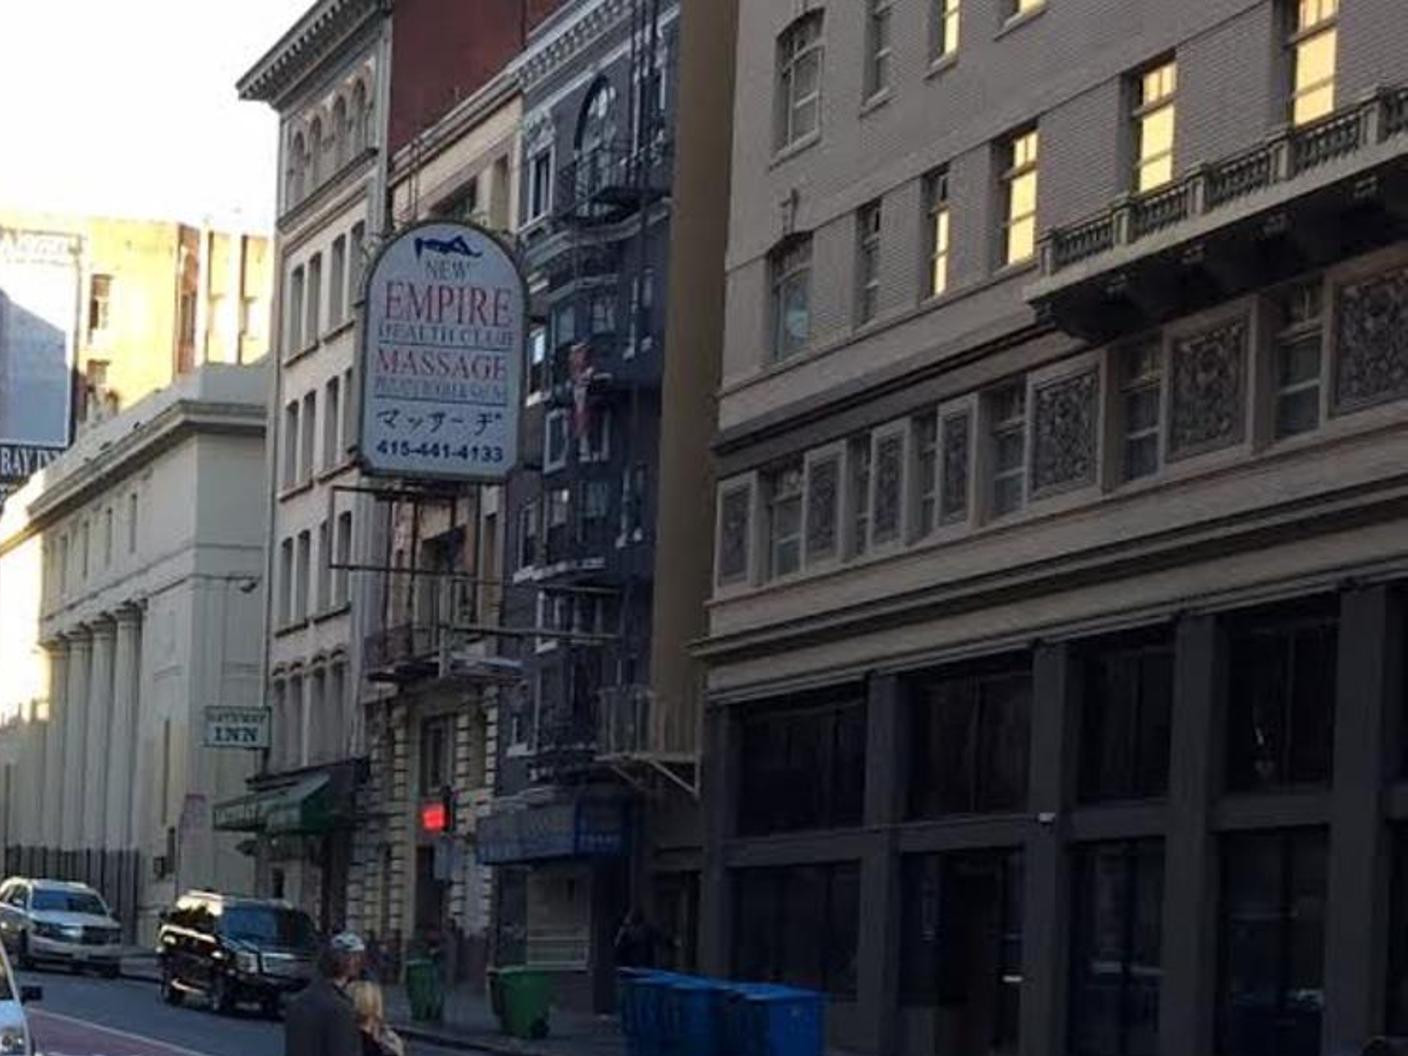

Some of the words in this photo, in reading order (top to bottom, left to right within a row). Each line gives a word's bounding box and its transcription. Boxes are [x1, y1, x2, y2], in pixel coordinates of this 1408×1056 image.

[426, 259, 471, 281] NEW
[386, 280, 513, 328] EMPIRE
[377, 348, 507, 381] MASSAGE
[0, 446, 32, 476] BAY
[215, 726, 258, 742] INN
